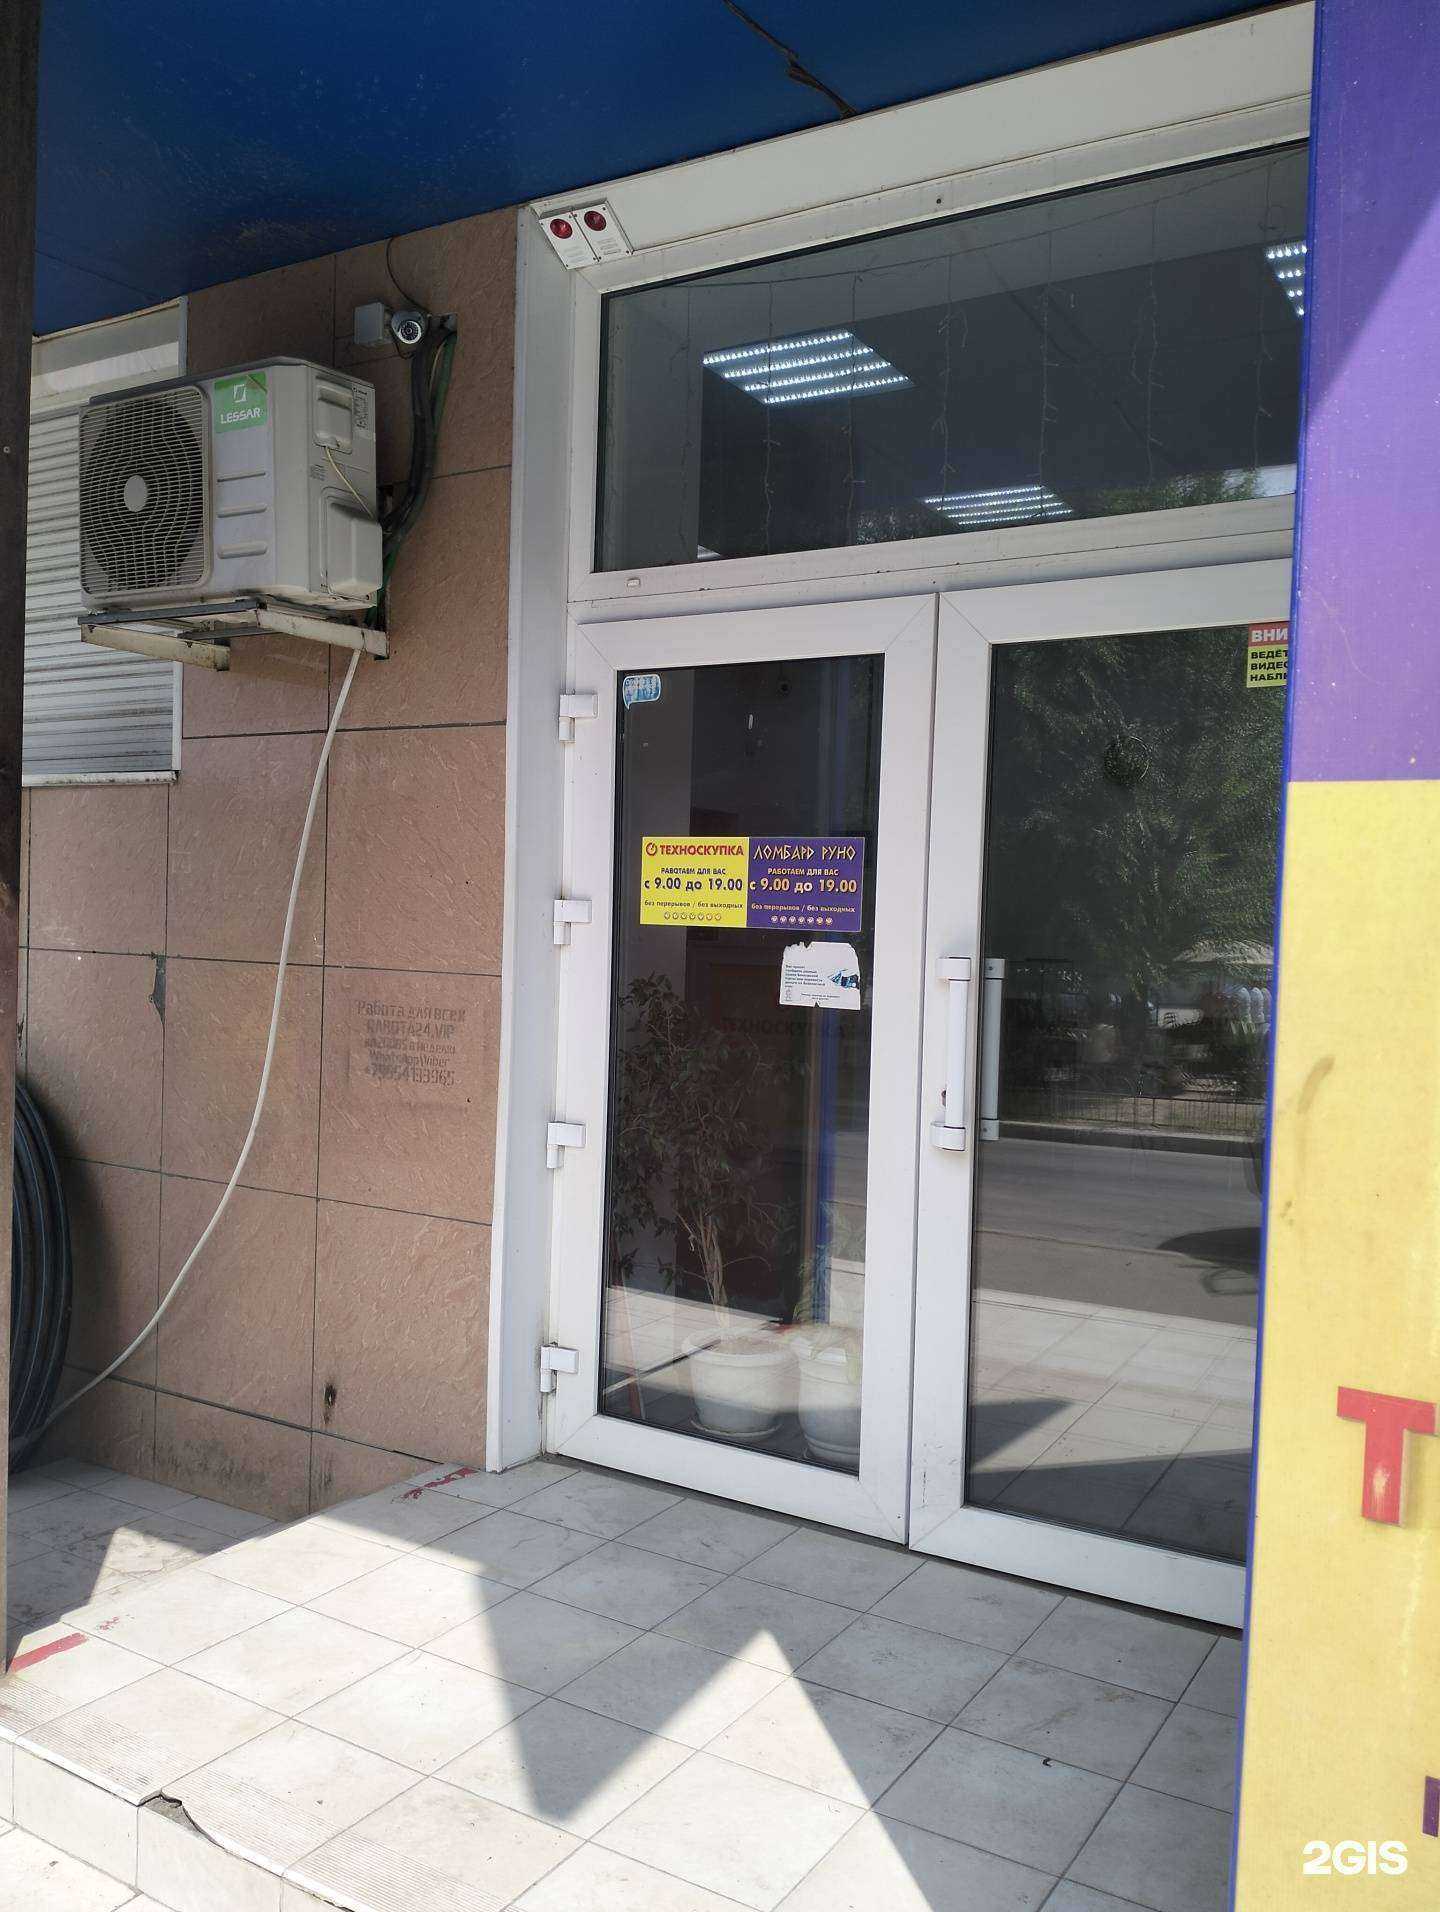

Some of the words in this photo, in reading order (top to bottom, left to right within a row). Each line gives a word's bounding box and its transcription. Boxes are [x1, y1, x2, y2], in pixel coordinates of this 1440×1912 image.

[220, 407, 261, 424] LESSAR
[1250, 672, 1287, 681] НАБЛ
[660, 844, 744, 856] ТЕХНОСКУПКА
[753, 844, 815, 860] ЛОМБАРД
[822, 845, 856, 860] РУНО
[661, 867, 695, 875] РАБОТАЕМ
[767, 868, 805, 876] РАБОТАЕМ
[806, 868, 822, 876] ДЛЯ
[654, 877, 681, 890] 9.00
[685, 881, 702, 892] до
[709, 878, 743, 891] 19.00
[760, 878, 790, 891] 9.00
[794, 882, 813, 893] до
[819, 879, 857, 893] 19.00
[751, 902, 763, 910] без
[806, 904, 819, 912] без
